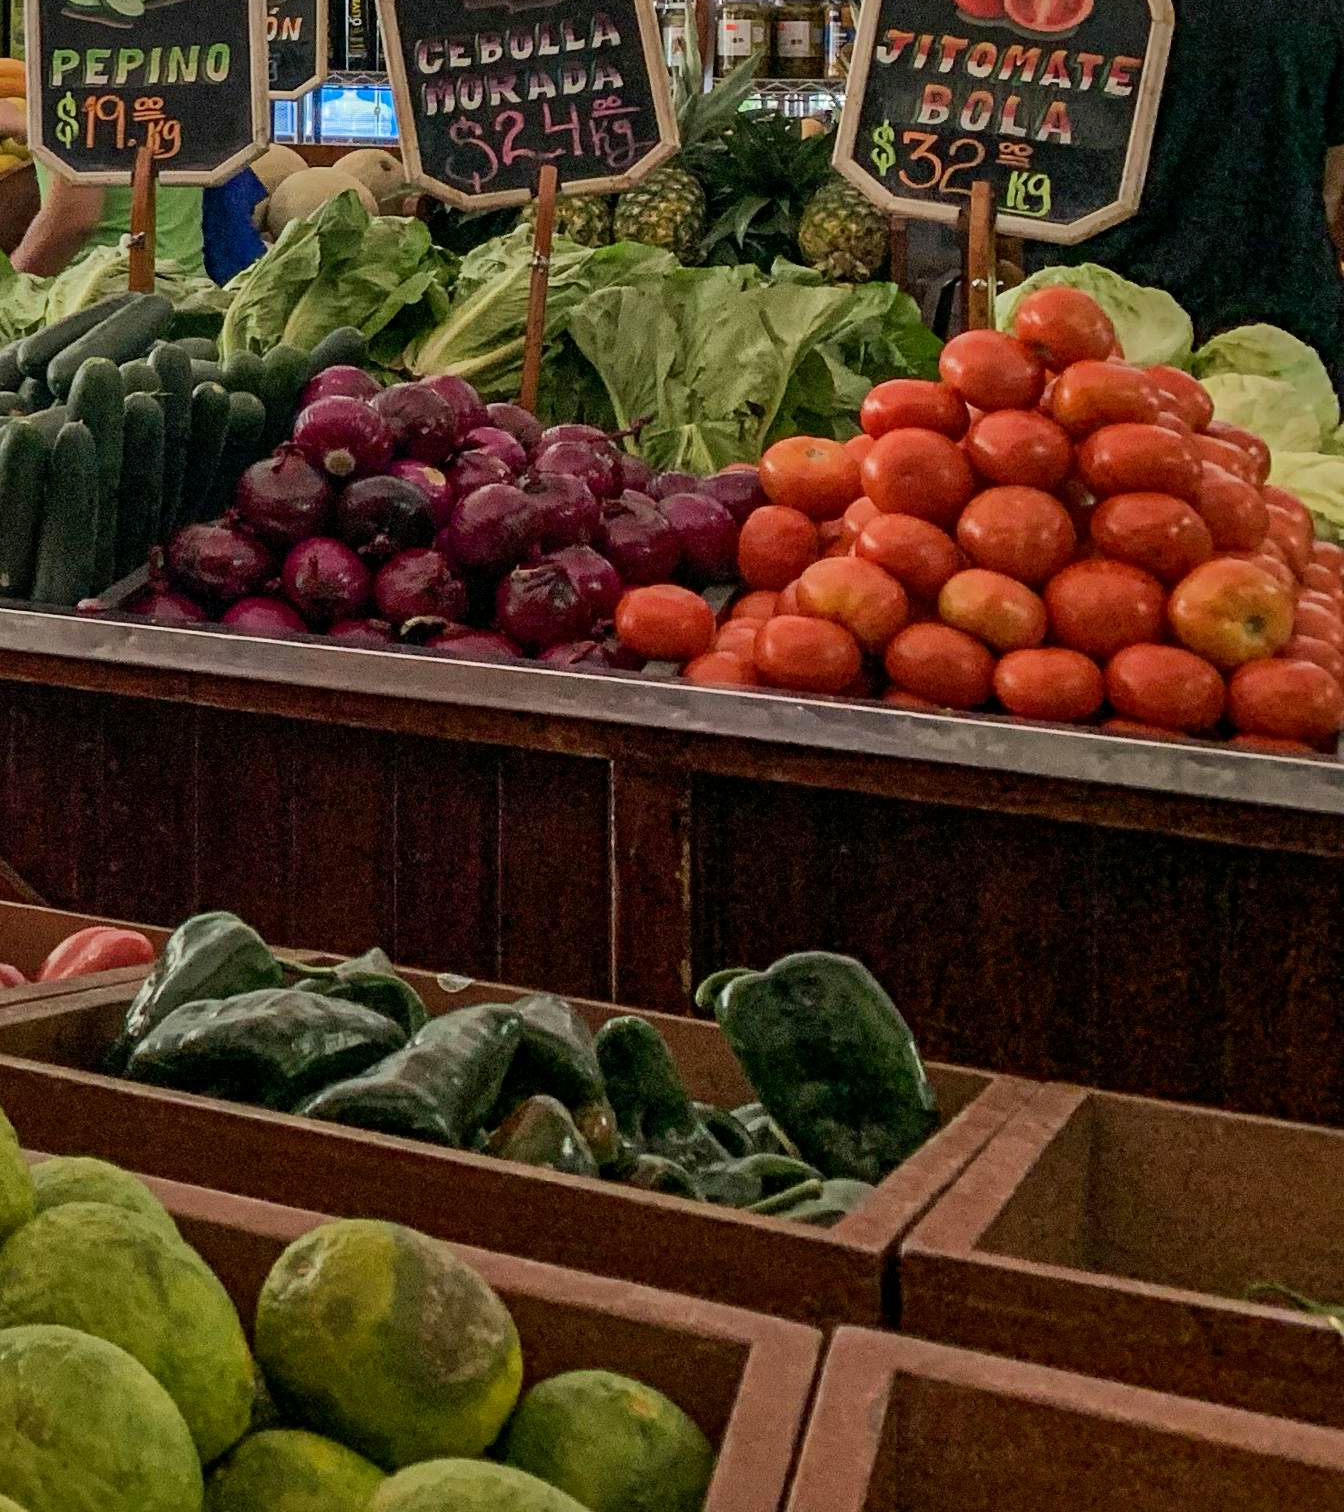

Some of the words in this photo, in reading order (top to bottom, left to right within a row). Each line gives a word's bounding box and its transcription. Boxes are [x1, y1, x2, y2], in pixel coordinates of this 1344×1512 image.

[50, 42, 232, 87] PEPINO
[415, 11, 622, 74] CEBOLLA
[876, 28, 1143, 96] JITOMATE
[422, 61, 624, 116] MORADA
[916, 83, 1072, 144] BOLA
